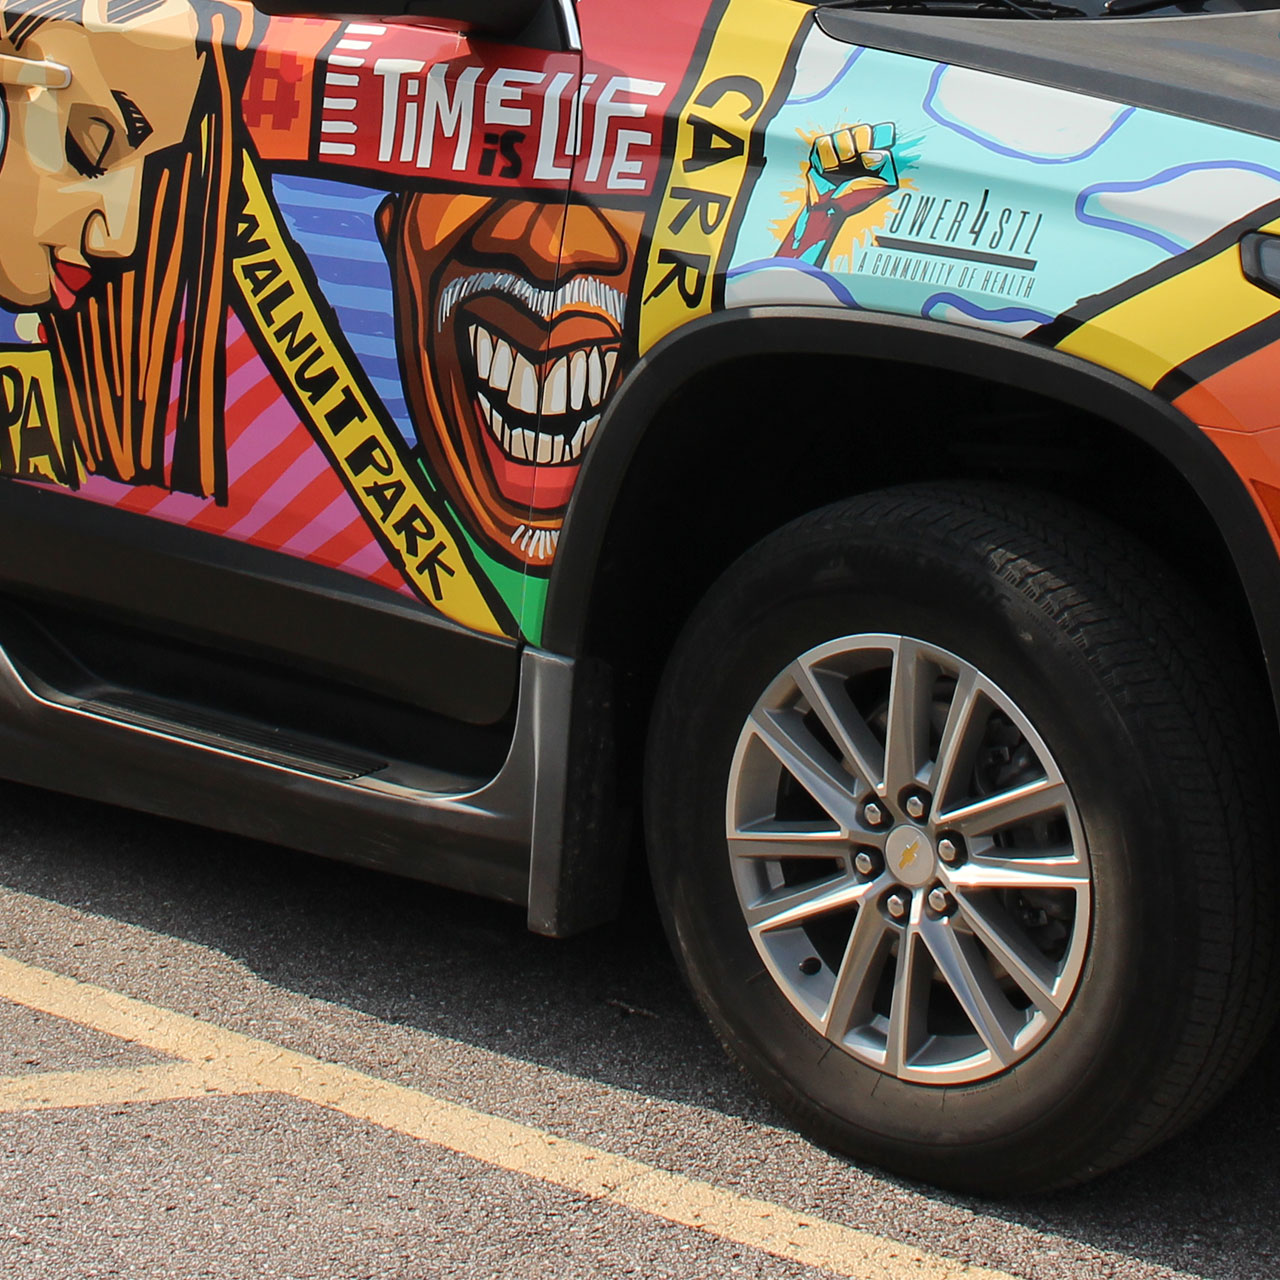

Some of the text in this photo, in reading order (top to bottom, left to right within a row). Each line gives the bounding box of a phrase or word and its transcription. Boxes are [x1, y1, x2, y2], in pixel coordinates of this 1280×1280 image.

[643, 75, 764, 309] CARR
[857, 252, 1036, 299] A COMMUNITY OF HEALTH
[344, 434, 456, 601] PARK
